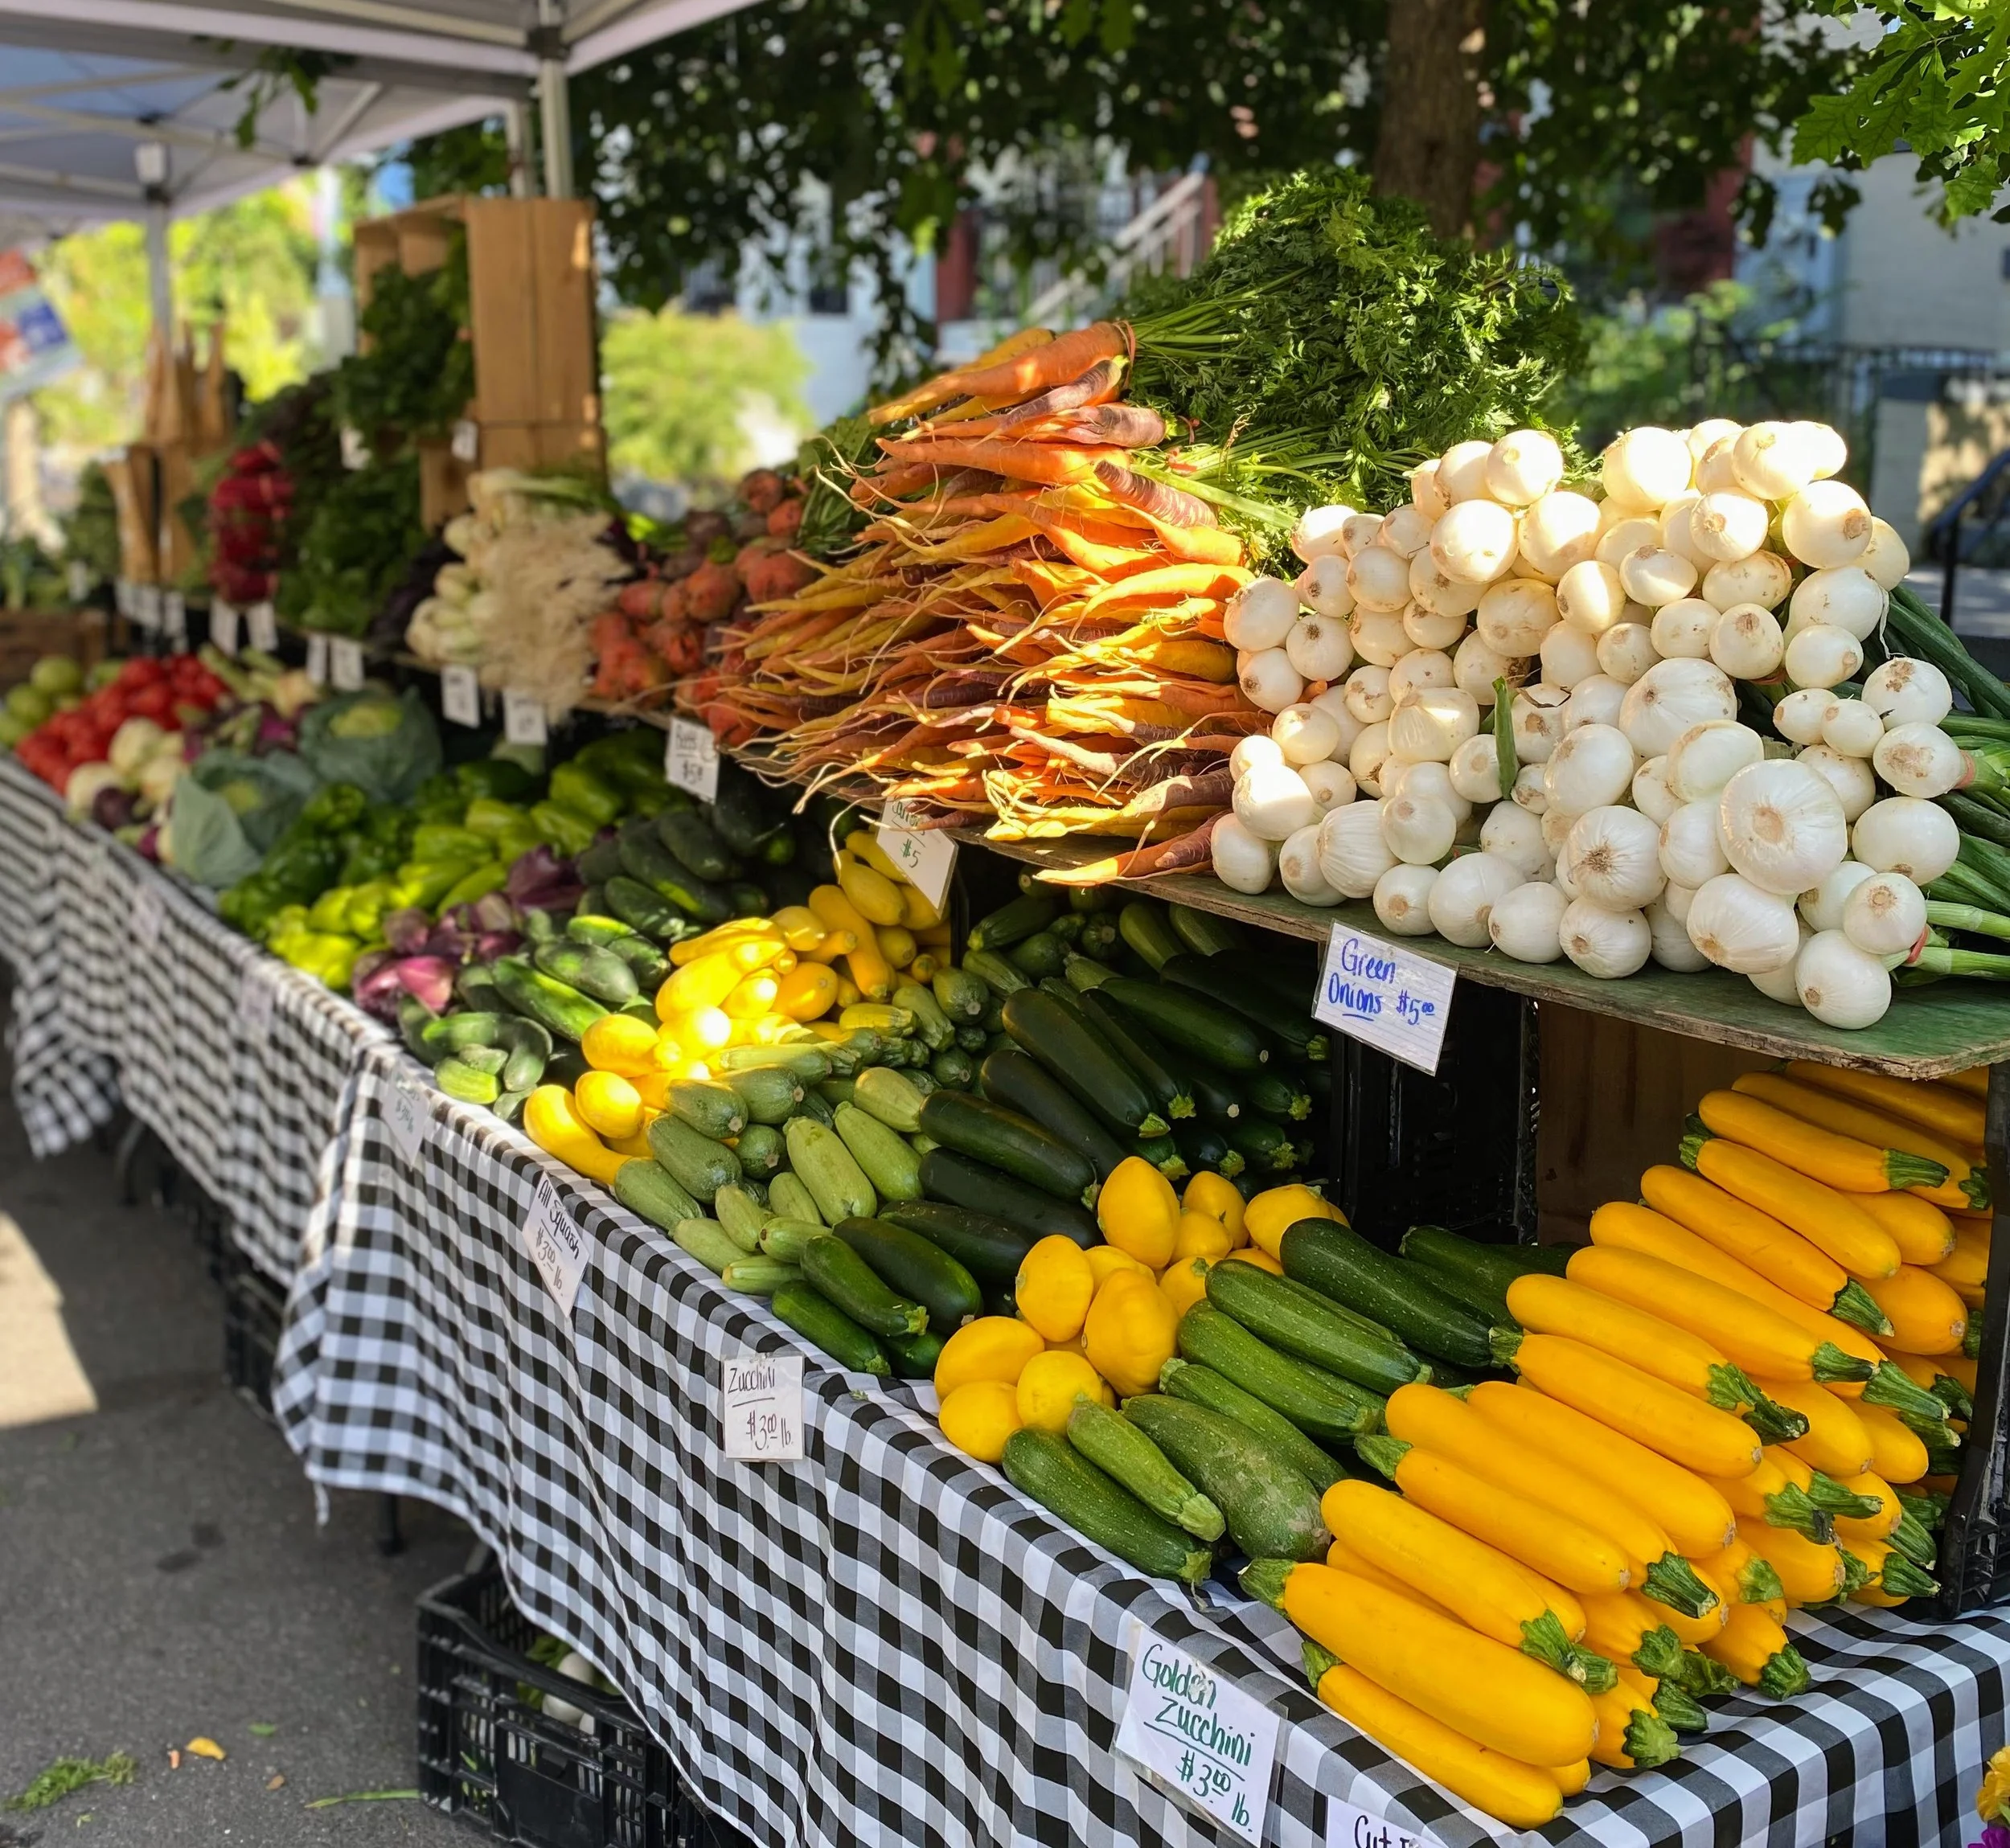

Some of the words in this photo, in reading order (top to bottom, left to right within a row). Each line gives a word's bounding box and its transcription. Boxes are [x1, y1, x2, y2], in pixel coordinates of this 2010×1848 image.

[900, 838, 921, 868] $5
[1341, 937, 1397, 984] Green
[1328, 972, 1384, 1014] Onions
[538, 1178, 553, 1209] All
[549, 1199, 580, 1260] Squash
[727, 1358, 776, 1395] Zucchini
[1142, 1643, 1217, 1711] Golden
[1155, 1696, 1256, 1767] Zucchini
